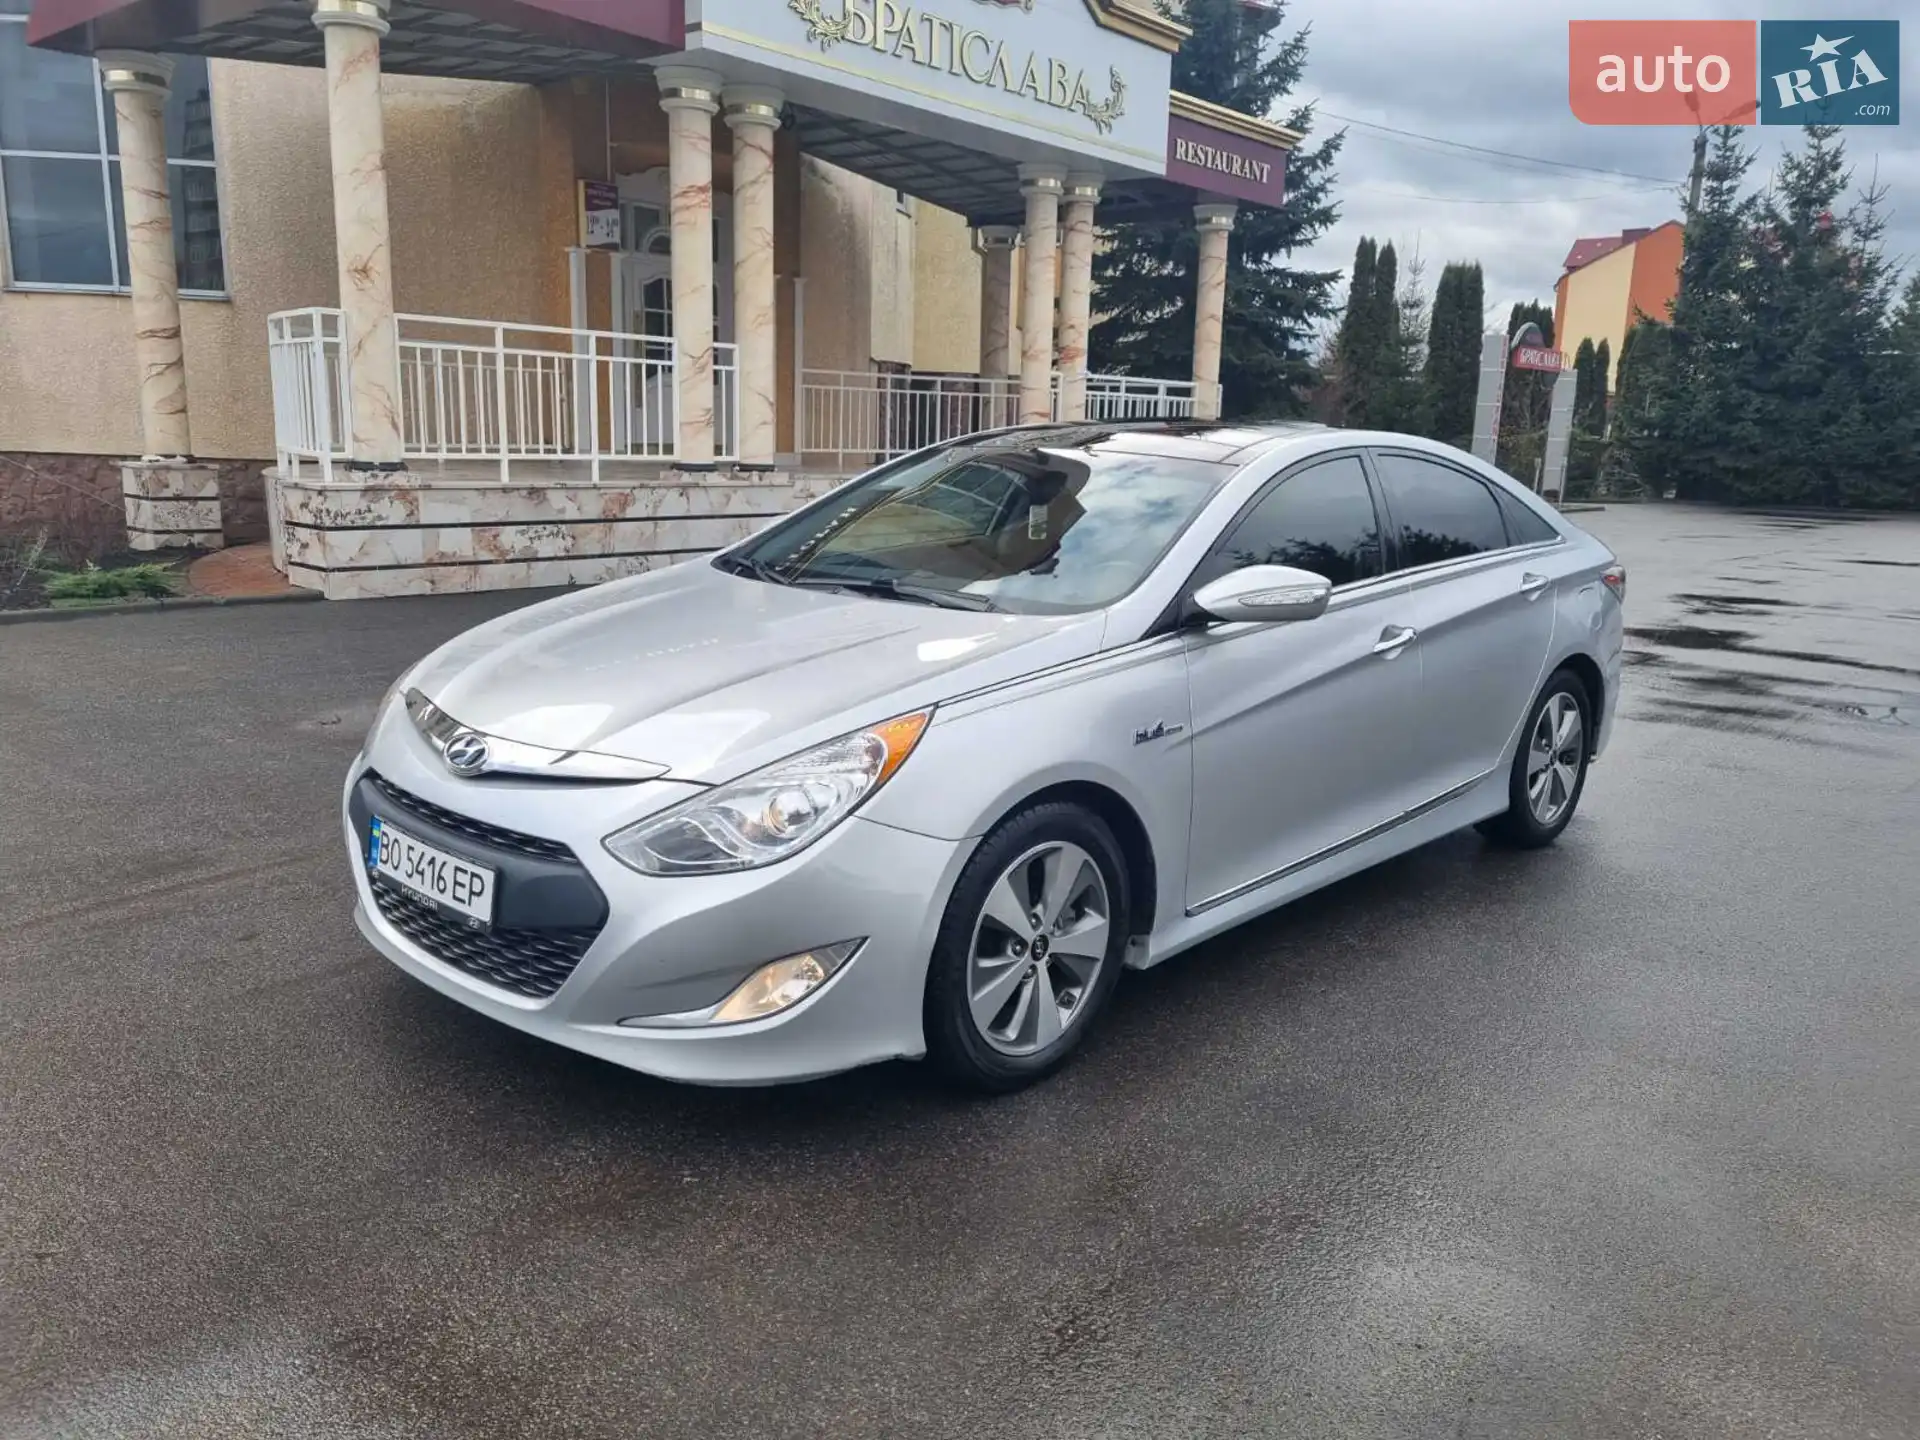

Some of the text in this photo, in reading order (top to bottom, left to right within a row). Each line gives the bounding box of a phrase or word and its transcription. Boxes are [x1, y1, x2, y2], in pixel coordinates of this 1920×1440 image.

[844, 0, 1090, 115] БРАТІСЛАВА
[1175, 137, 1271, 183] RESTAURANT
[379, 830, 485, 906] BO 5416 EP
[401, 883, 439, 911] HYUNDAI
